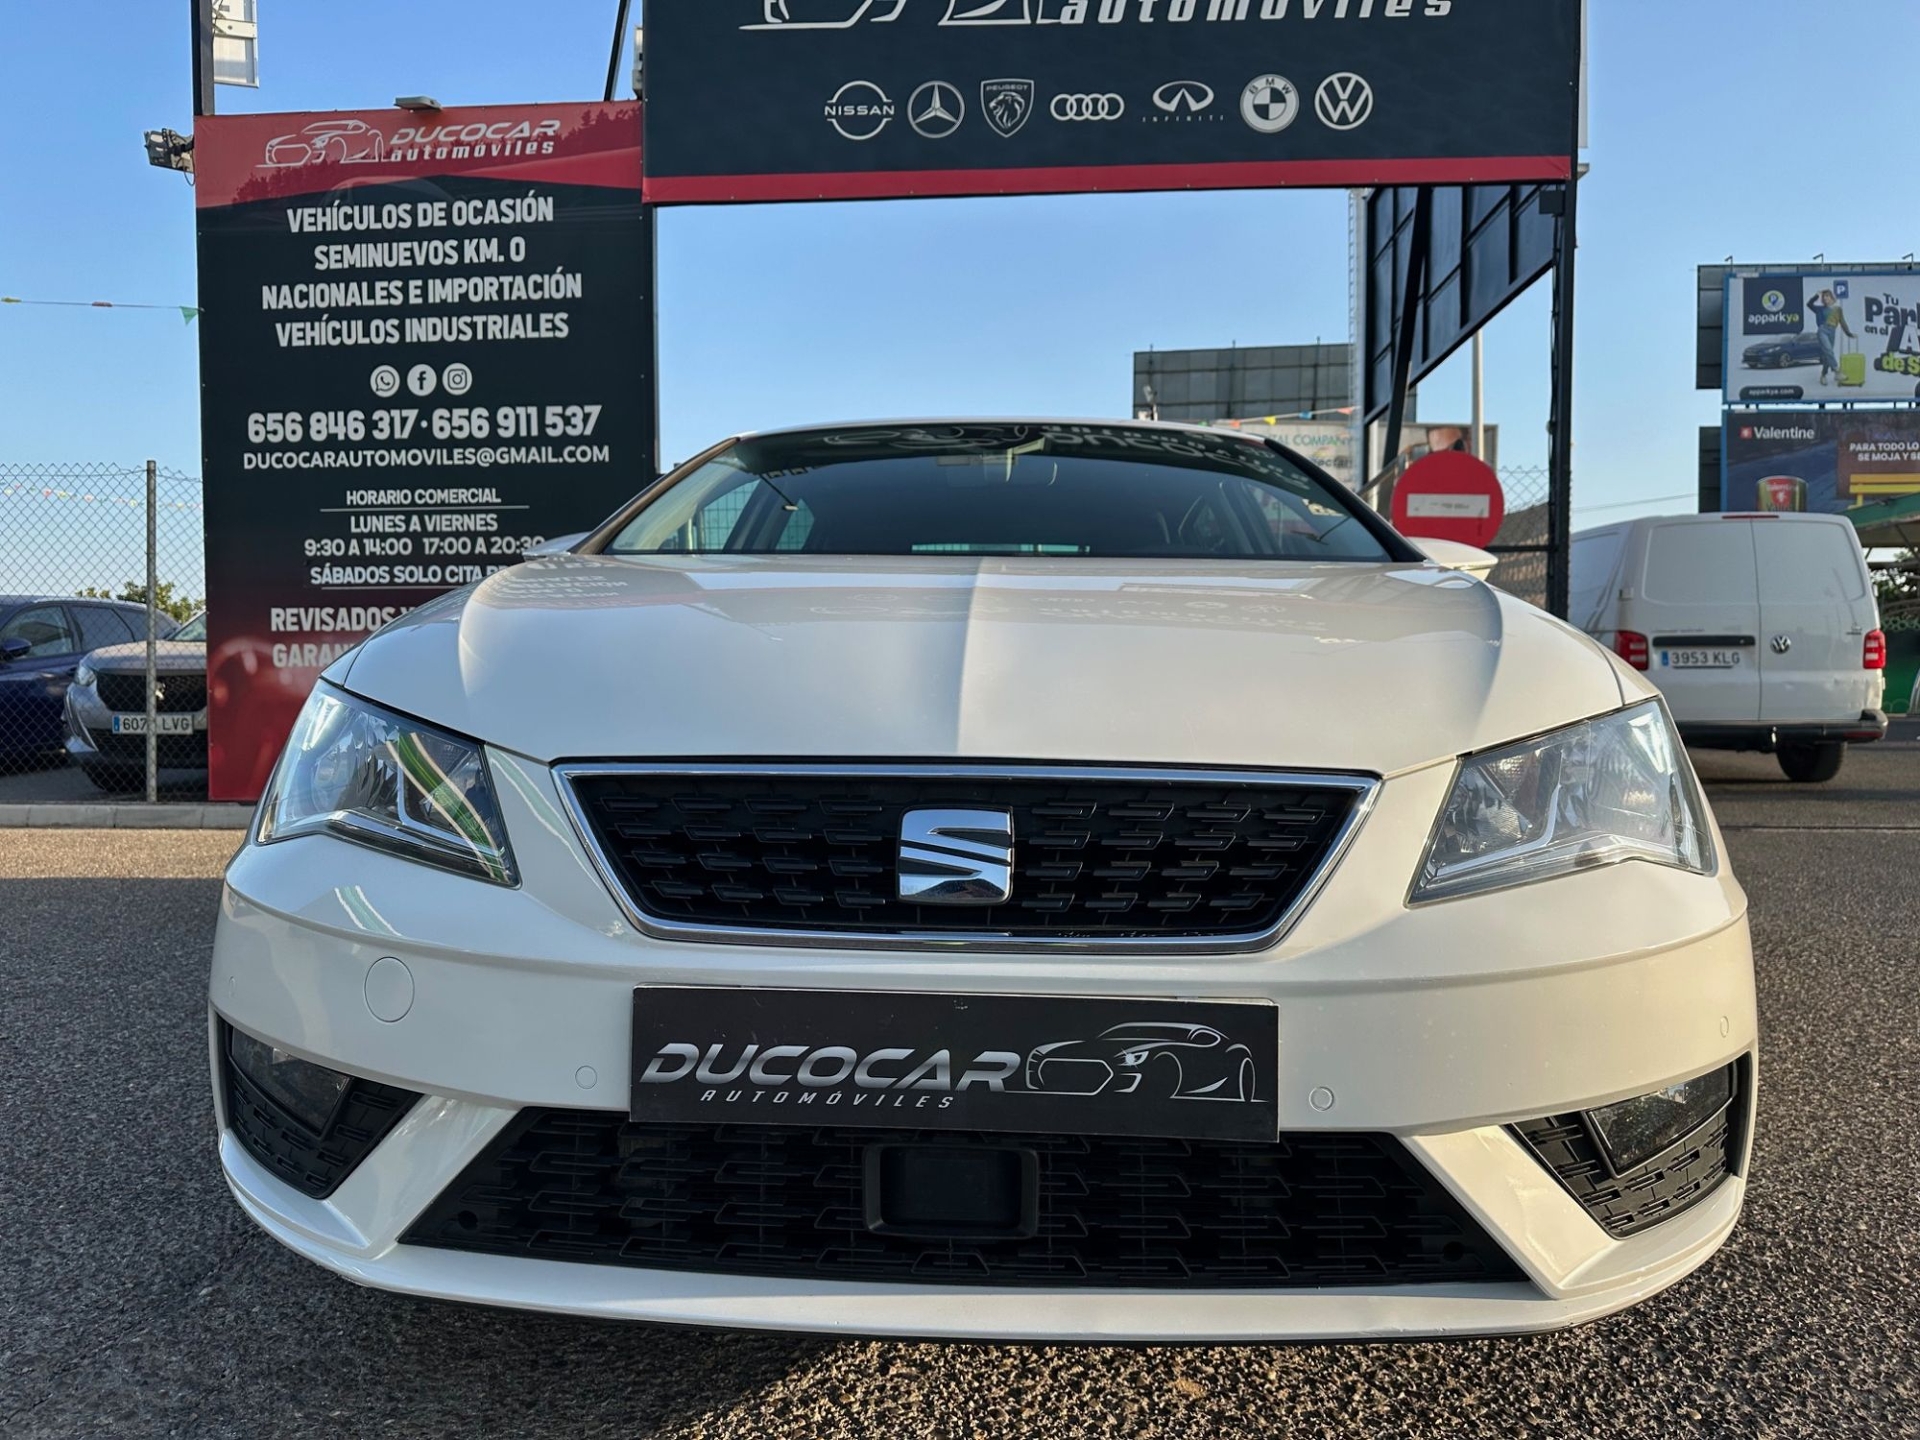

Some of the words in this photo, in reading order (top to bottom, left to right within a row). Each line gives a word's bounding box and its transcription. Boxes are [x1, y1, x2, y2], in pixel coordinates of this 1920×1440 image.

[986, 84, 1029, 92] PEUGEOT
[824, 105, 895, 116] NISSAN
[389, 119, 562, 145] DUCOCAR
[287, 199, 412, 233] VEHÍCULOS
[417, 203, 447, 227] DE
[451, 189, 555, 226] OCASIÓN
[314, 239, 459, 271] SEMINUEVOS
[463, 239, 504, 264] KM.
[262, 279, 404, 310] NACIONALES
[408, 279, 423, 304] E
[427, 266, 583, 303] IMPORTACIÓN
[1883, 292, 1900, 306] Tu
[1748, 311, 1800, 325] apparkya
[275, 314, 400, 348] VEHÍCULOS
[404, 312, 570, 343] INDUSTRIALES
[1864, 325, 1878, 335] en
[1879, 325, 1889, 336] el
[1881, 352, 1906, 372] de
[1749, 388, 1795, 396] apparkya.com
[247, 411, 303, 443] 656
[309, 410, 366, 442] 846
[371, 409, 419, 440] 317
[431, 408, 490, 439] 656
[496, 407, 539, 438] 911
[544, 405, 602, 437] 537
[1754, 426, 1815, 440] Valentine
[1850, 443, 1876, 451] PARA
[1878, 442, 1905, 451] TODO
[1907, 441, 1920, 450] LO
[242, 445, 611, 470] DUCOCARAUTOMOVILES@GMAIL.COM
[1858, 454, 1870, 462] SE
[1871, 453, 1900, 461] MOJA
[1902, 453, 1910, 461] Y
[345, 488, 412, 506] HORARIO
[414, 488, 502, 504] COMERCIAL
[350, 515, 406, 533] LUNES
[408, 514, 422, 532] A
[424, 513, 499, 532] VIERNES
[304, 538, 346, 557] 9:30
[348, 538, 361, 556] A
[362, 537, 413, 556] 14:00
[422, 536, 473, 555] 17:00
[475, 535, 488, 554] A
[310, 562, 391, 585] SÁBADOS
[393, 564, 442, 583] SOLO
[445, 563, 483, 583] CITA
[1671, 652, 1708, 665] 3953
[1713, 651, 1740, 664] KLG
[163, 717, 190, 731] LVG
[639, 1043, 1021, 1092] DUCOCAR
[700, 1089, 955, 1110] AUTOMÓVILES
